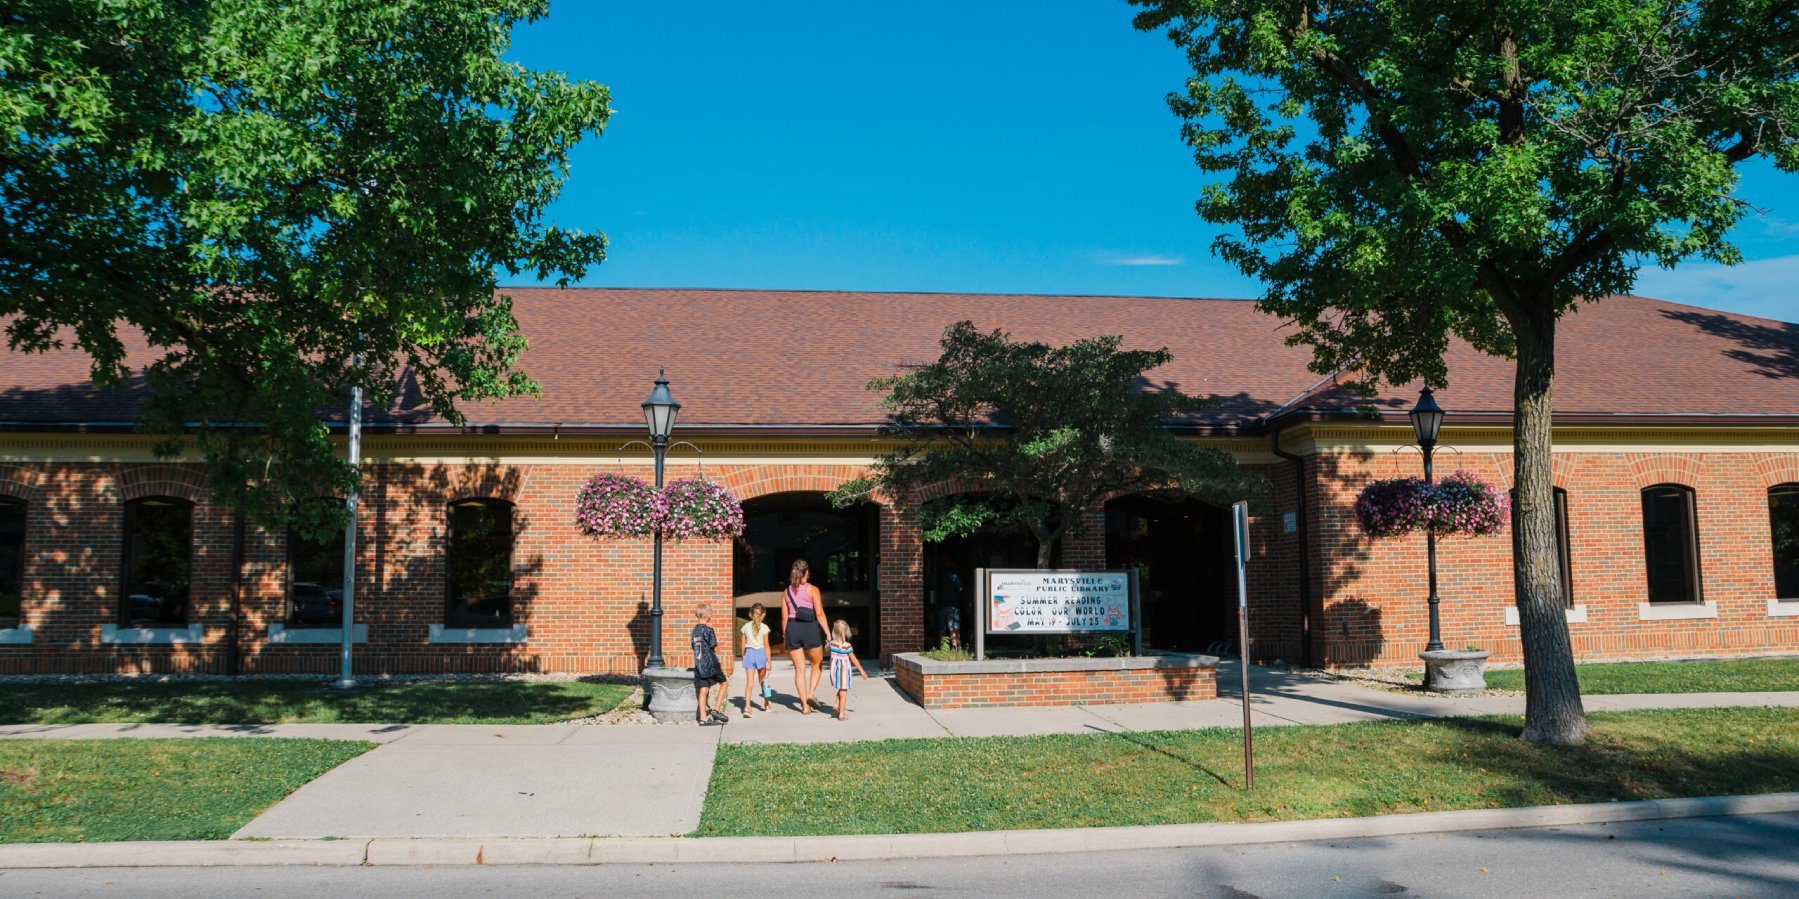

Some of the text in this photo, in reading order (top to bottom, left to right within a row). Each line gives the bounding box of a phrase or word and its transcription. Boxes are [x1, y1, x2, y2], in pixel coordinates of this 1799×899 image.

[1042, 577, 1103, 585] MARYSVILLE
[1020, 596, 1101, 605] SUMMER READING
[1014, 606, 1105, 616] COLOR OUR WORLD
[1027, 617, 1045, 626] MAY
[1066, 617, 1086, 626] JULY
[1089, 617, 1100, 626] 25
